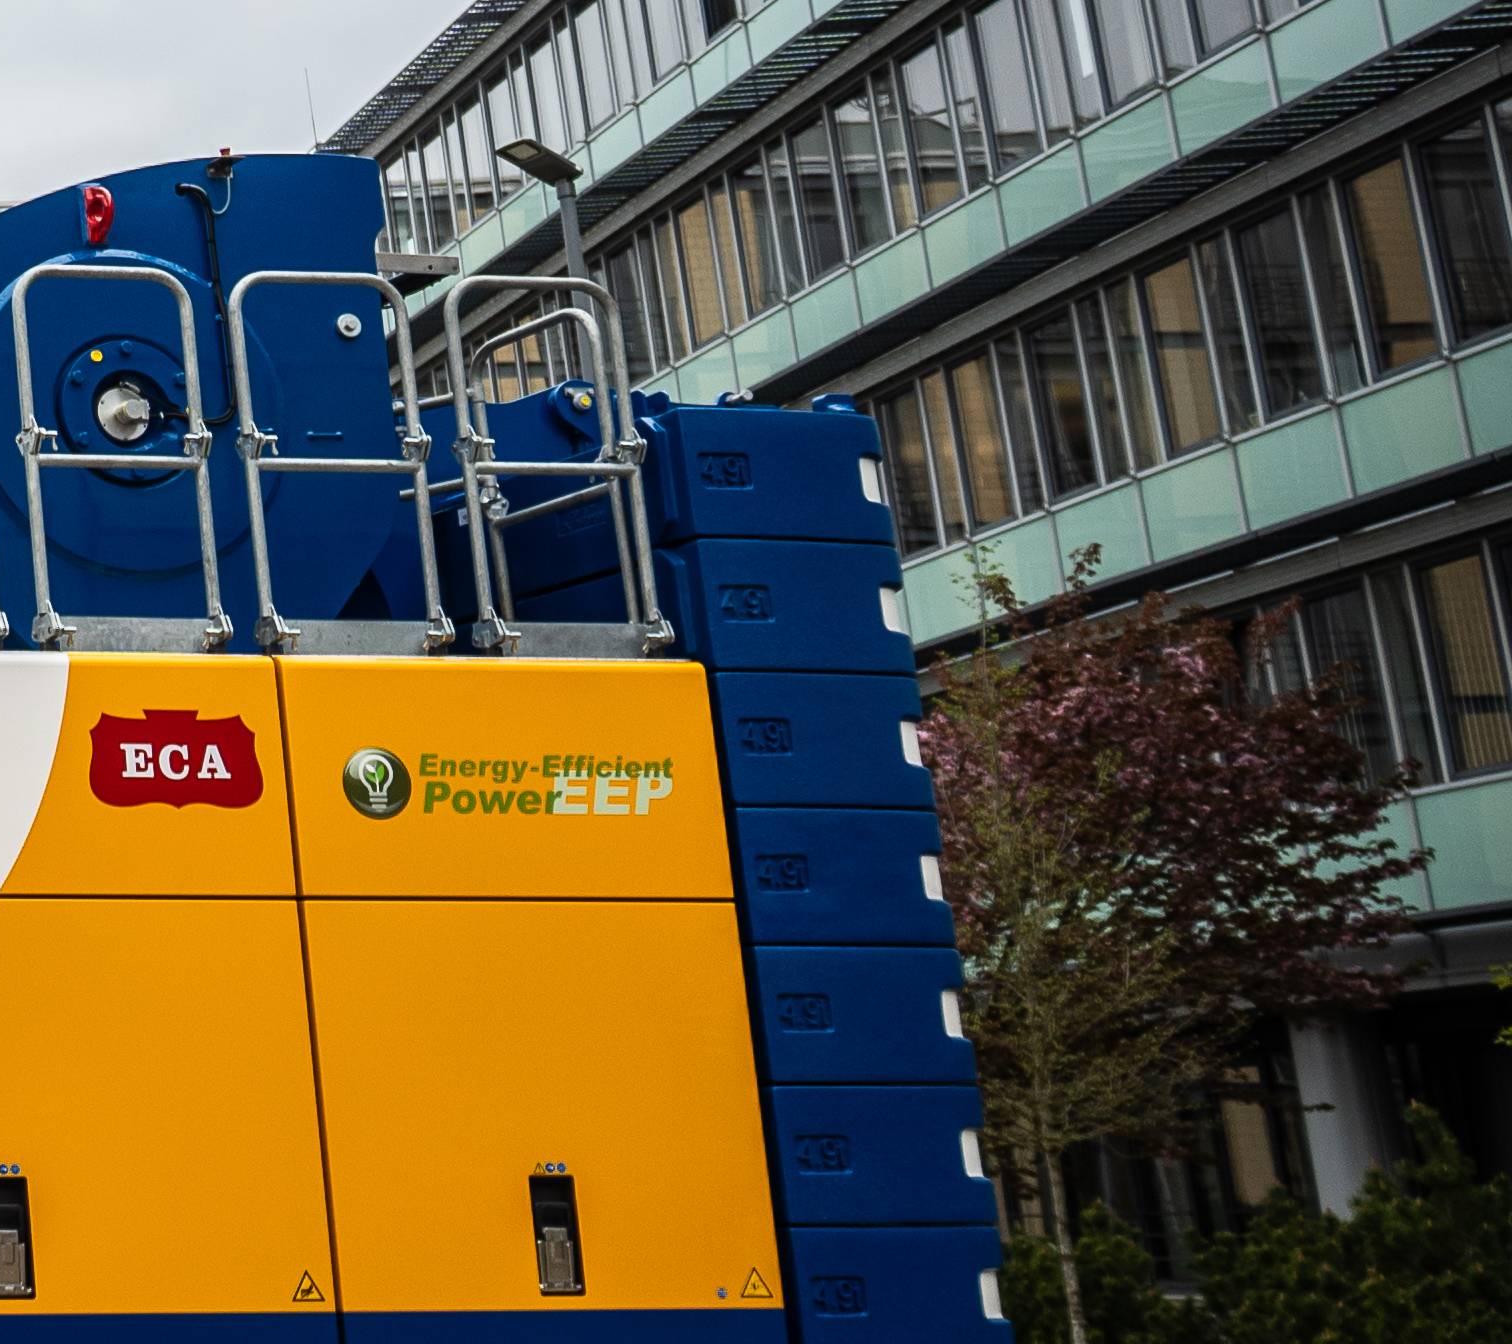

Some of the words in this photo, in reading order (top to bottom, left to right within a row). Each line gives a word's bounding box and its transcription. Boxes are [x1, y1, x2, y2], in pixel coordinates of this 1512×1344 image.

[119, 742, 232, 781] ECA
[419, 753, 674, 784] Energy-Efficient
[423, 781, 563, 815] Power
[552, 769, 673, 815] EEP
